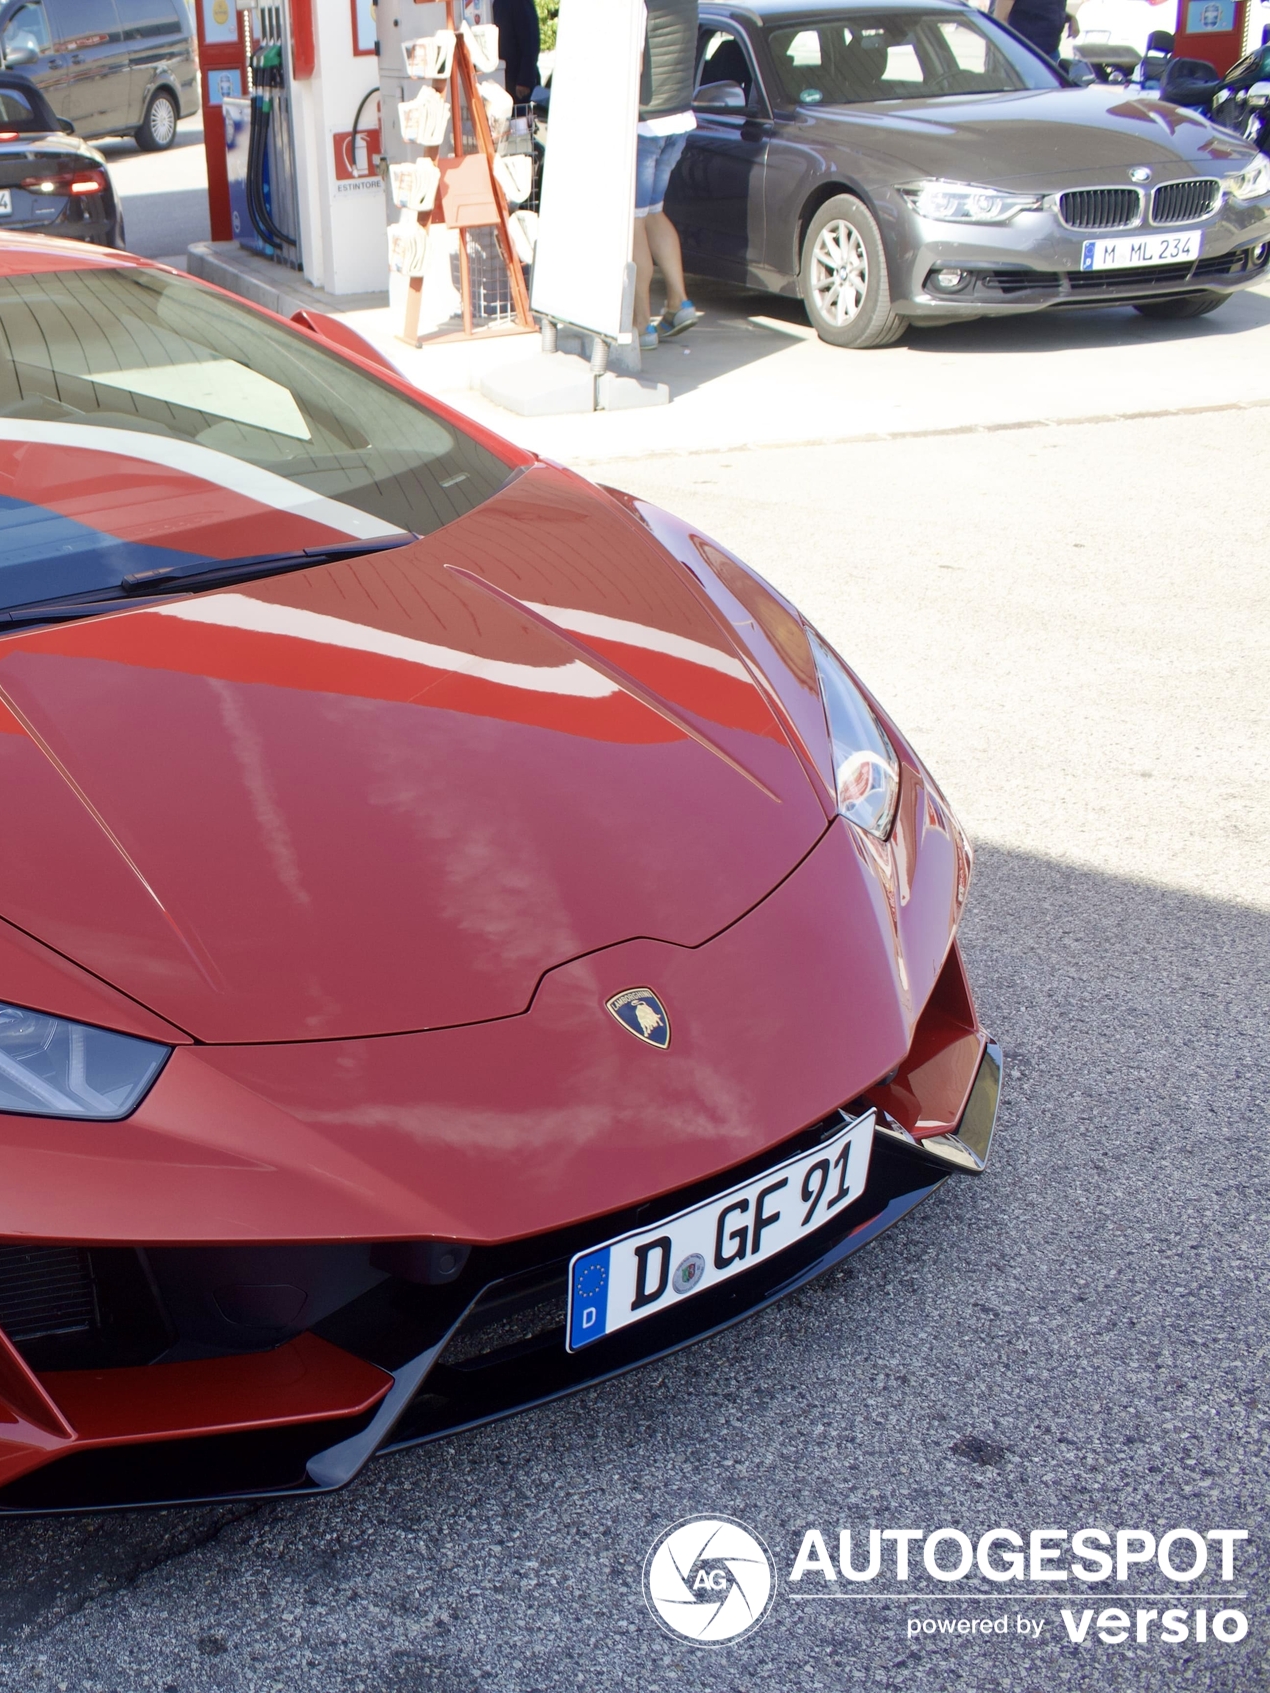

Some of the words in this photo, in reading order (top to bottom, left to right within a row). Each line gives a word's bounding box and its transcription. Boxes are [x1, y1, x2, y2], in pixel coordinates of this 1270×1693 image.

[337, 180, 382, 192] ESTINTORE
[1103, 245, 1116, 264] M
[1130, 242, 1153, 262] ML
[1158, 237, 1191, 260] 234
[630, 1235, 672, 1312] D
[713, 1176, 789, 1270] GF
[801, 1139, 852, 1227] 91
[582, 1306, 597, 1329] D
